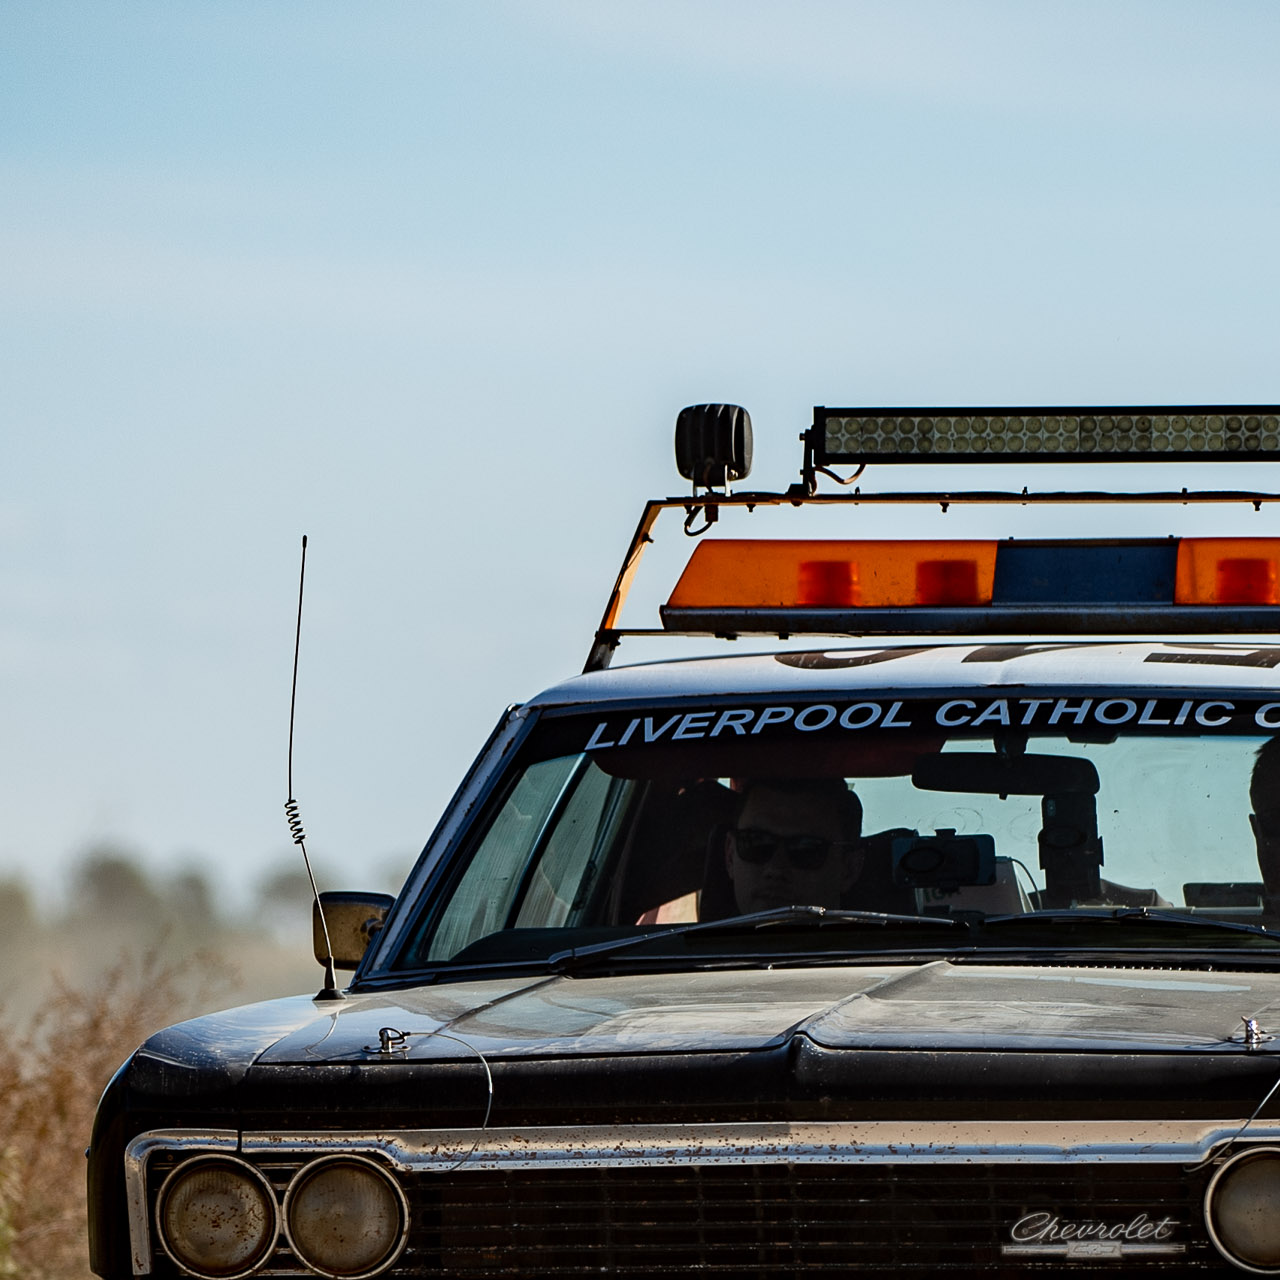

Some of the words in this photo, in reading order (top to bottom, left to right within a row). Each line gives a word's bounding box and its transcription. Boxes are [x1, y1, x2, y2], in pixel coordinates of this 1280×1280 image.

[584, 701, 913, 750] LIVERPOOL
[935, 699, 1234, 726] CATHOLIC
[1011, 1212, 1181, 1242] Chevrolet
